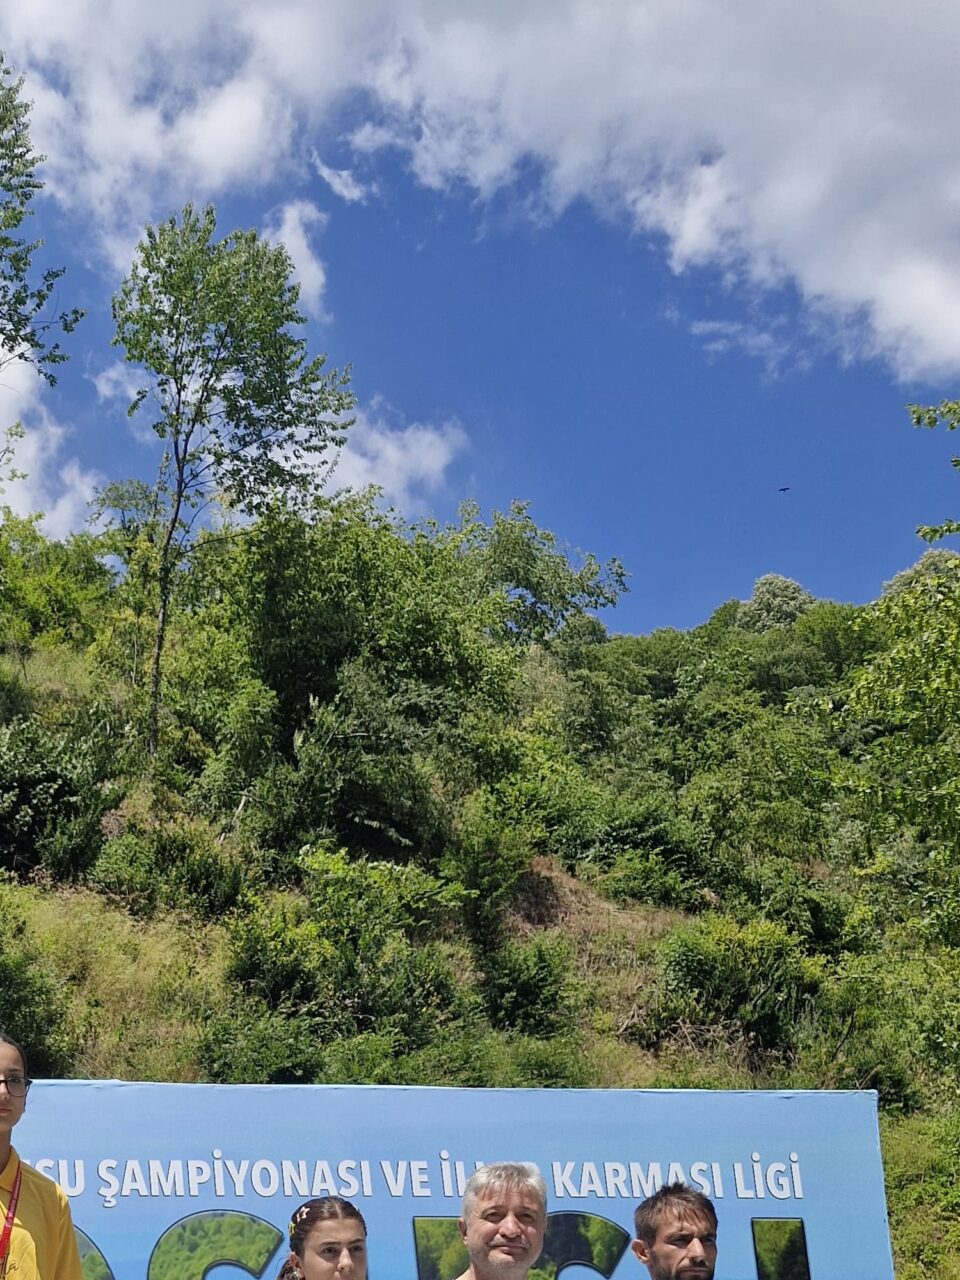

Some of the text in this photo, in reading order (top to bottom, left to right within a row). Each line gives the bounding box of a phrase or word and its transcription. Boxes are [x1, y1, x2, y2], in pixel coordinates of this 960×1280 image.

[97, 1149, 373, 1208] ŞAMPİYONASI
[380, 1159, 431, 1198] VE
[733, 1151, 804, 1200] LİGİ
